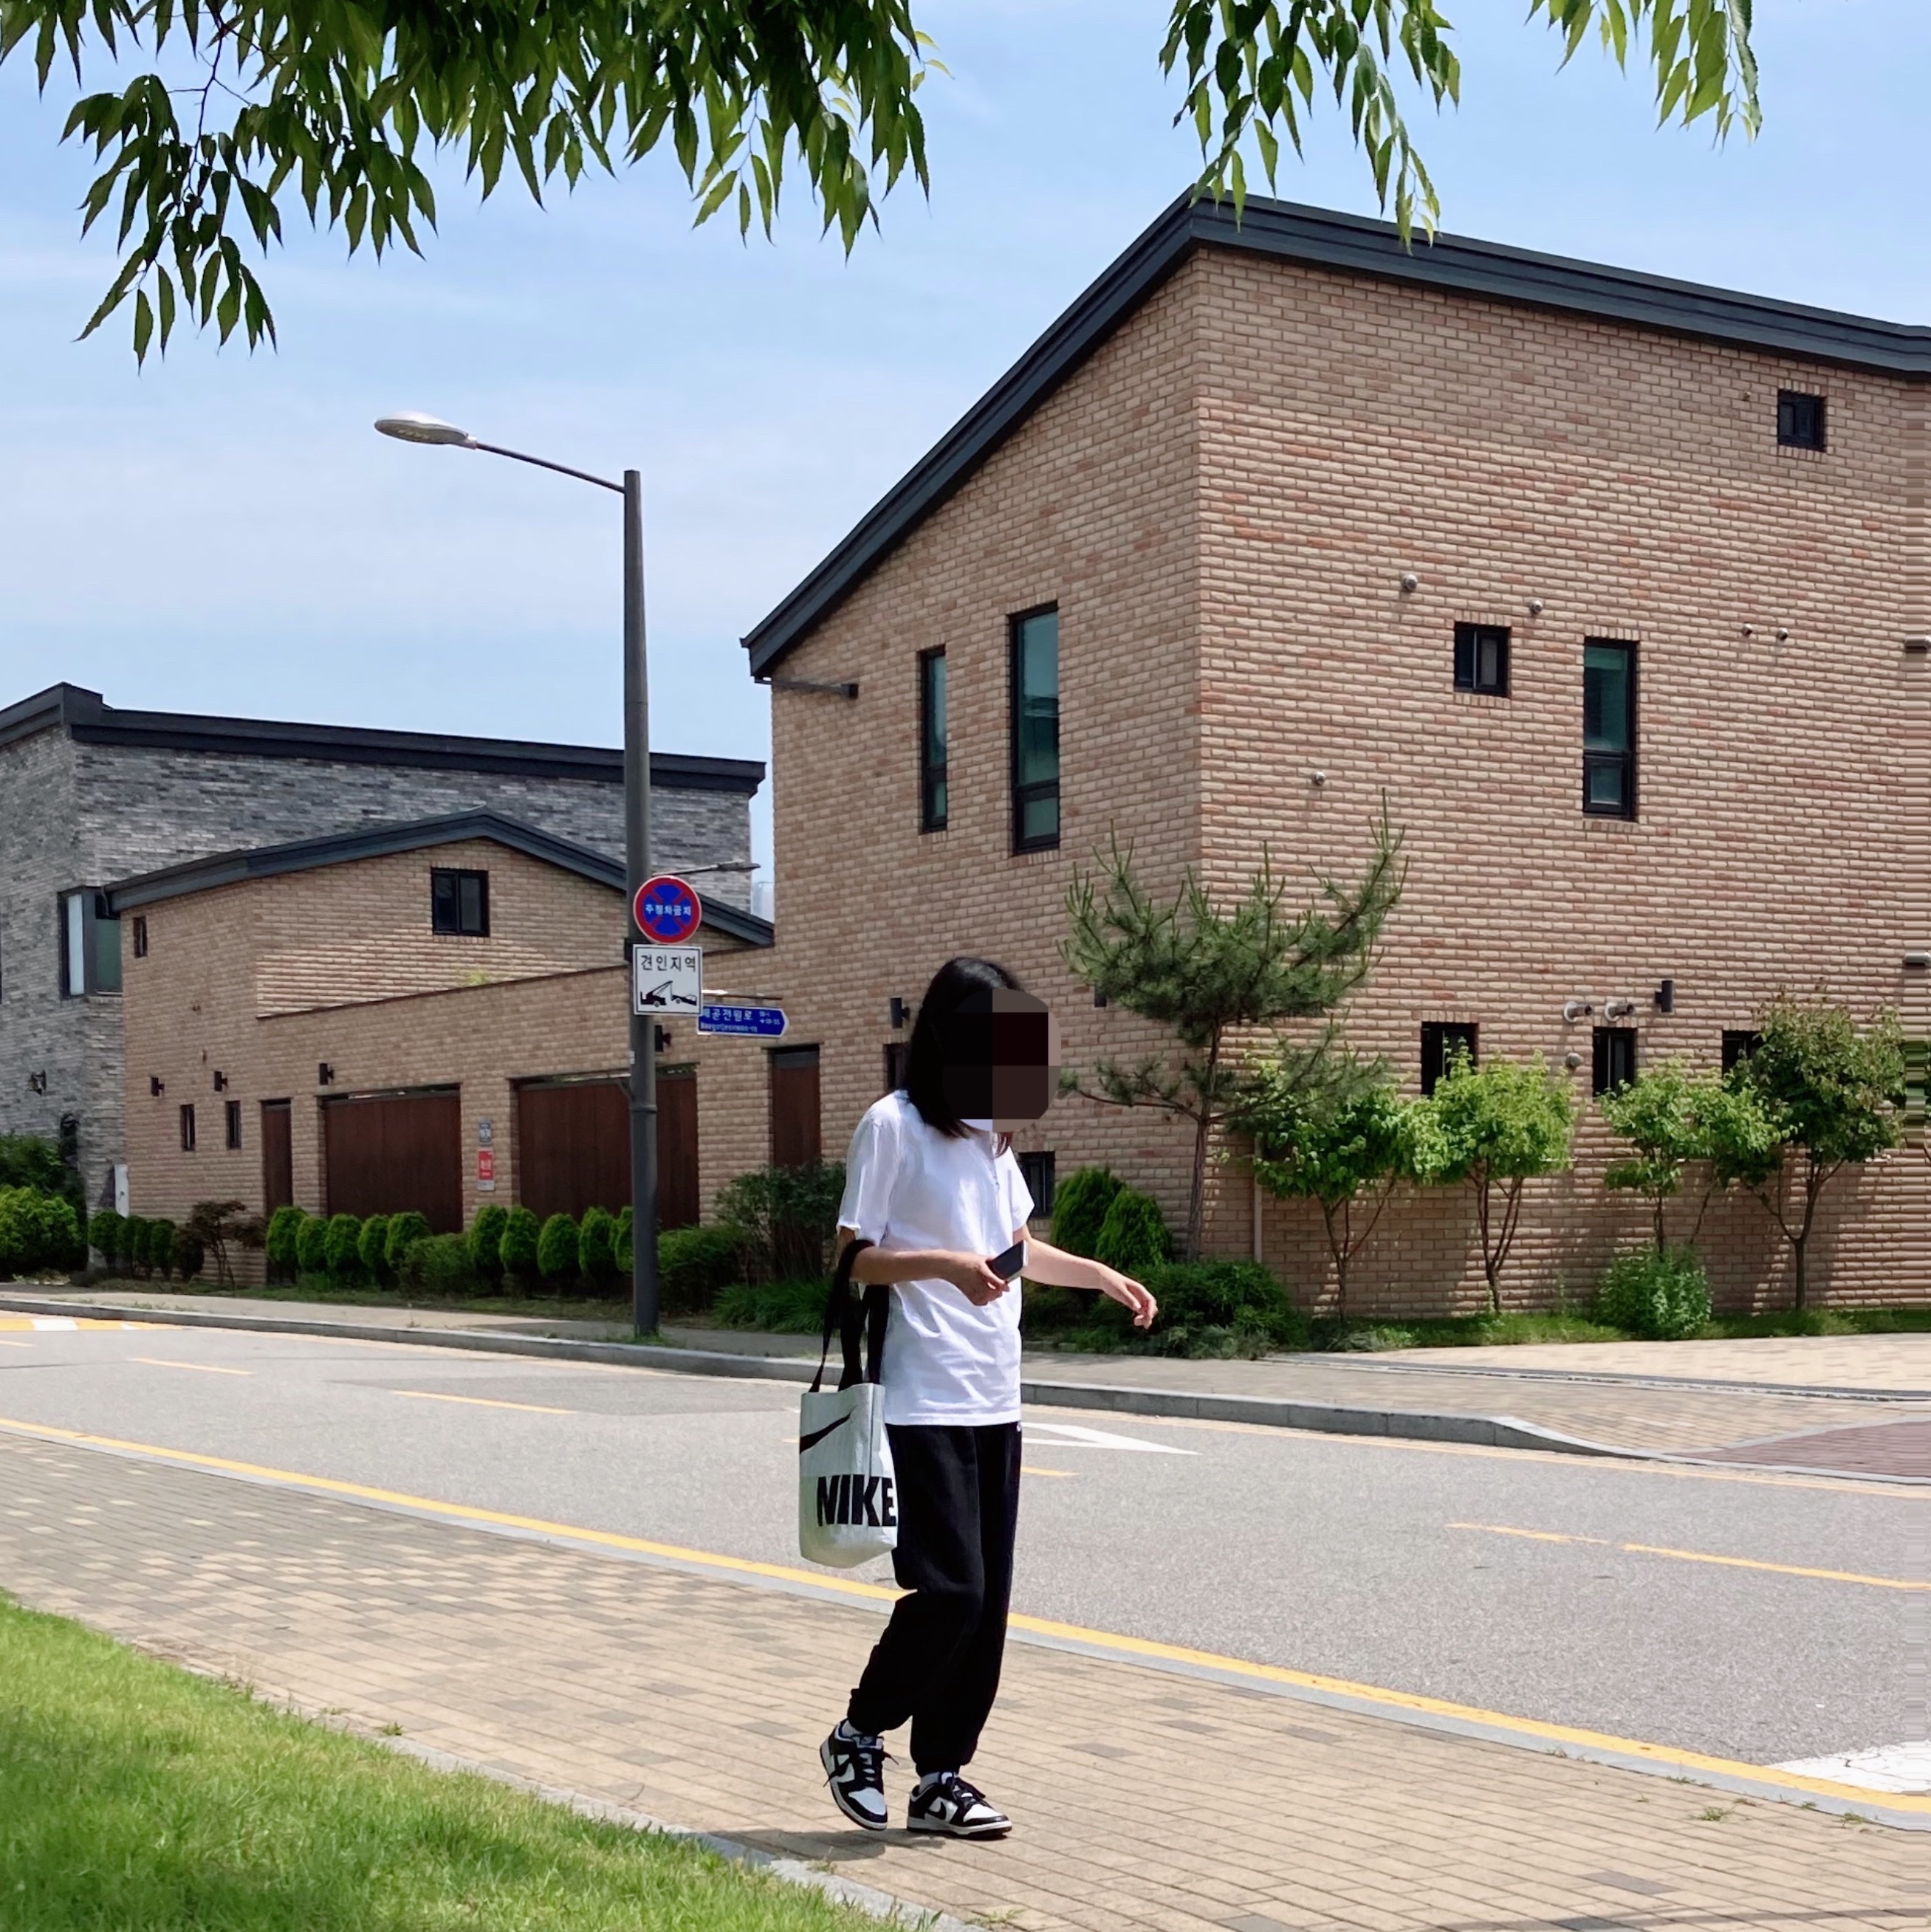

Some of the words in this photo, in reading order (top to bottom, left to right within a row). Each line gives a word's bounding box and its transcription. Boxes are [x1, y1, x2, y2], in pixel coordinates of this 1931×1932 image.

[645, 904, 691, 916] 주정차금지
[640, 954, 696, 972] 견인지역
[817, 1474, 896, 1527] NIKE
